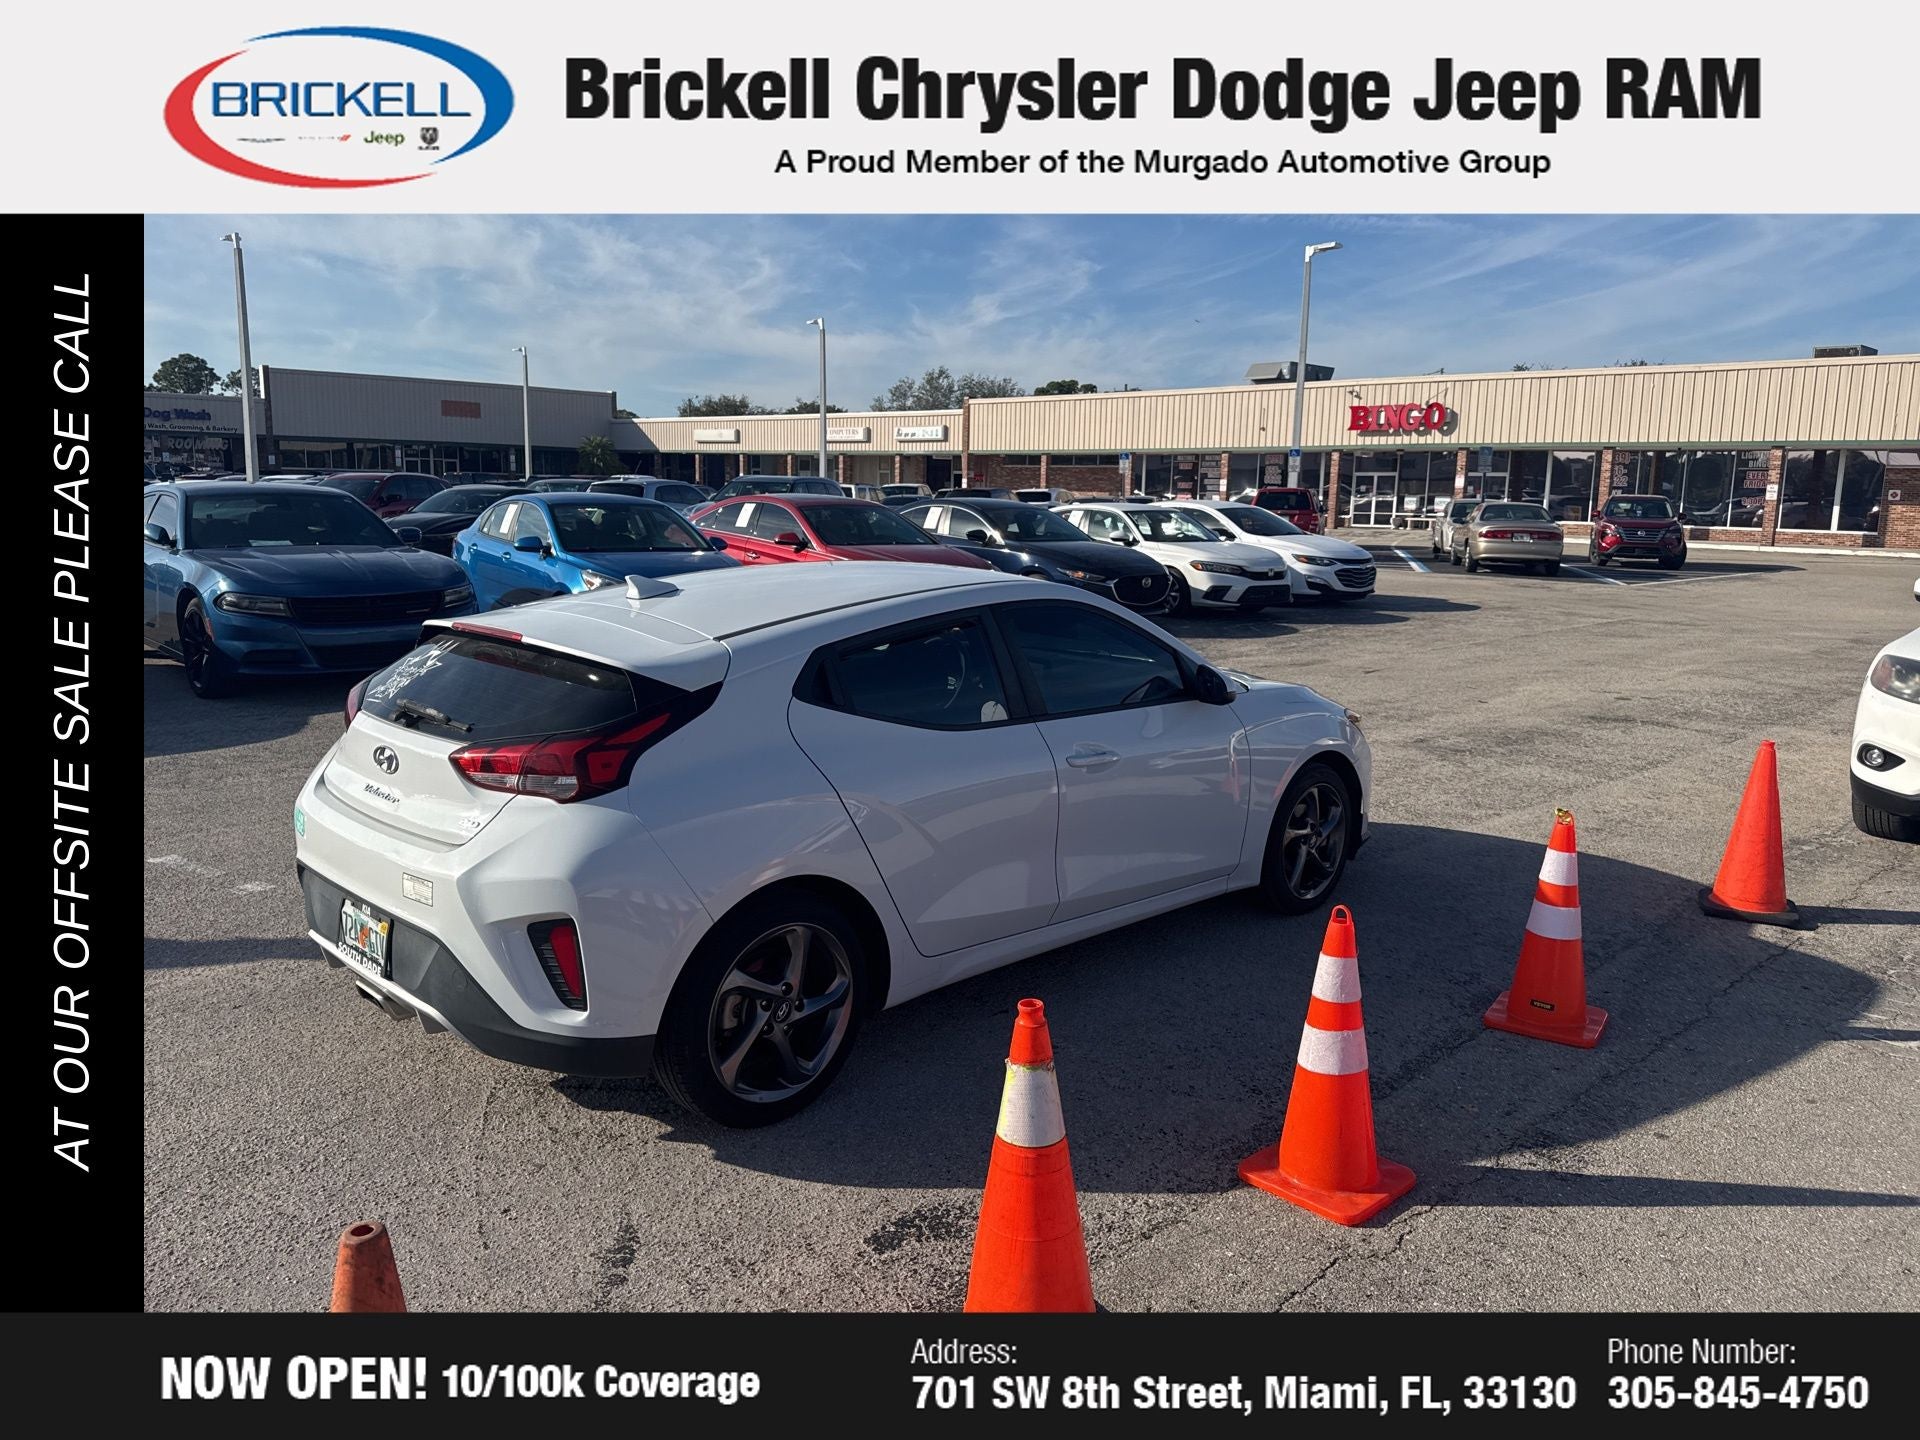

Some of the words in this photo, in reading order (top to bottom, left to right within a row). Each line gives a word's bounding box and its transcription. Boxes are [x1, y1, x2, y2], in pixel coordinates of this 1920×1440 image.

[1347, 402, 1446, 431] BINGO
[828, 427, 859, 436] OMPUTERS
[1743, 480, 1767, 489] FRIDA
[337, 941, 362, 965] SOUTH
[362, 957, 382, 977] DADE
